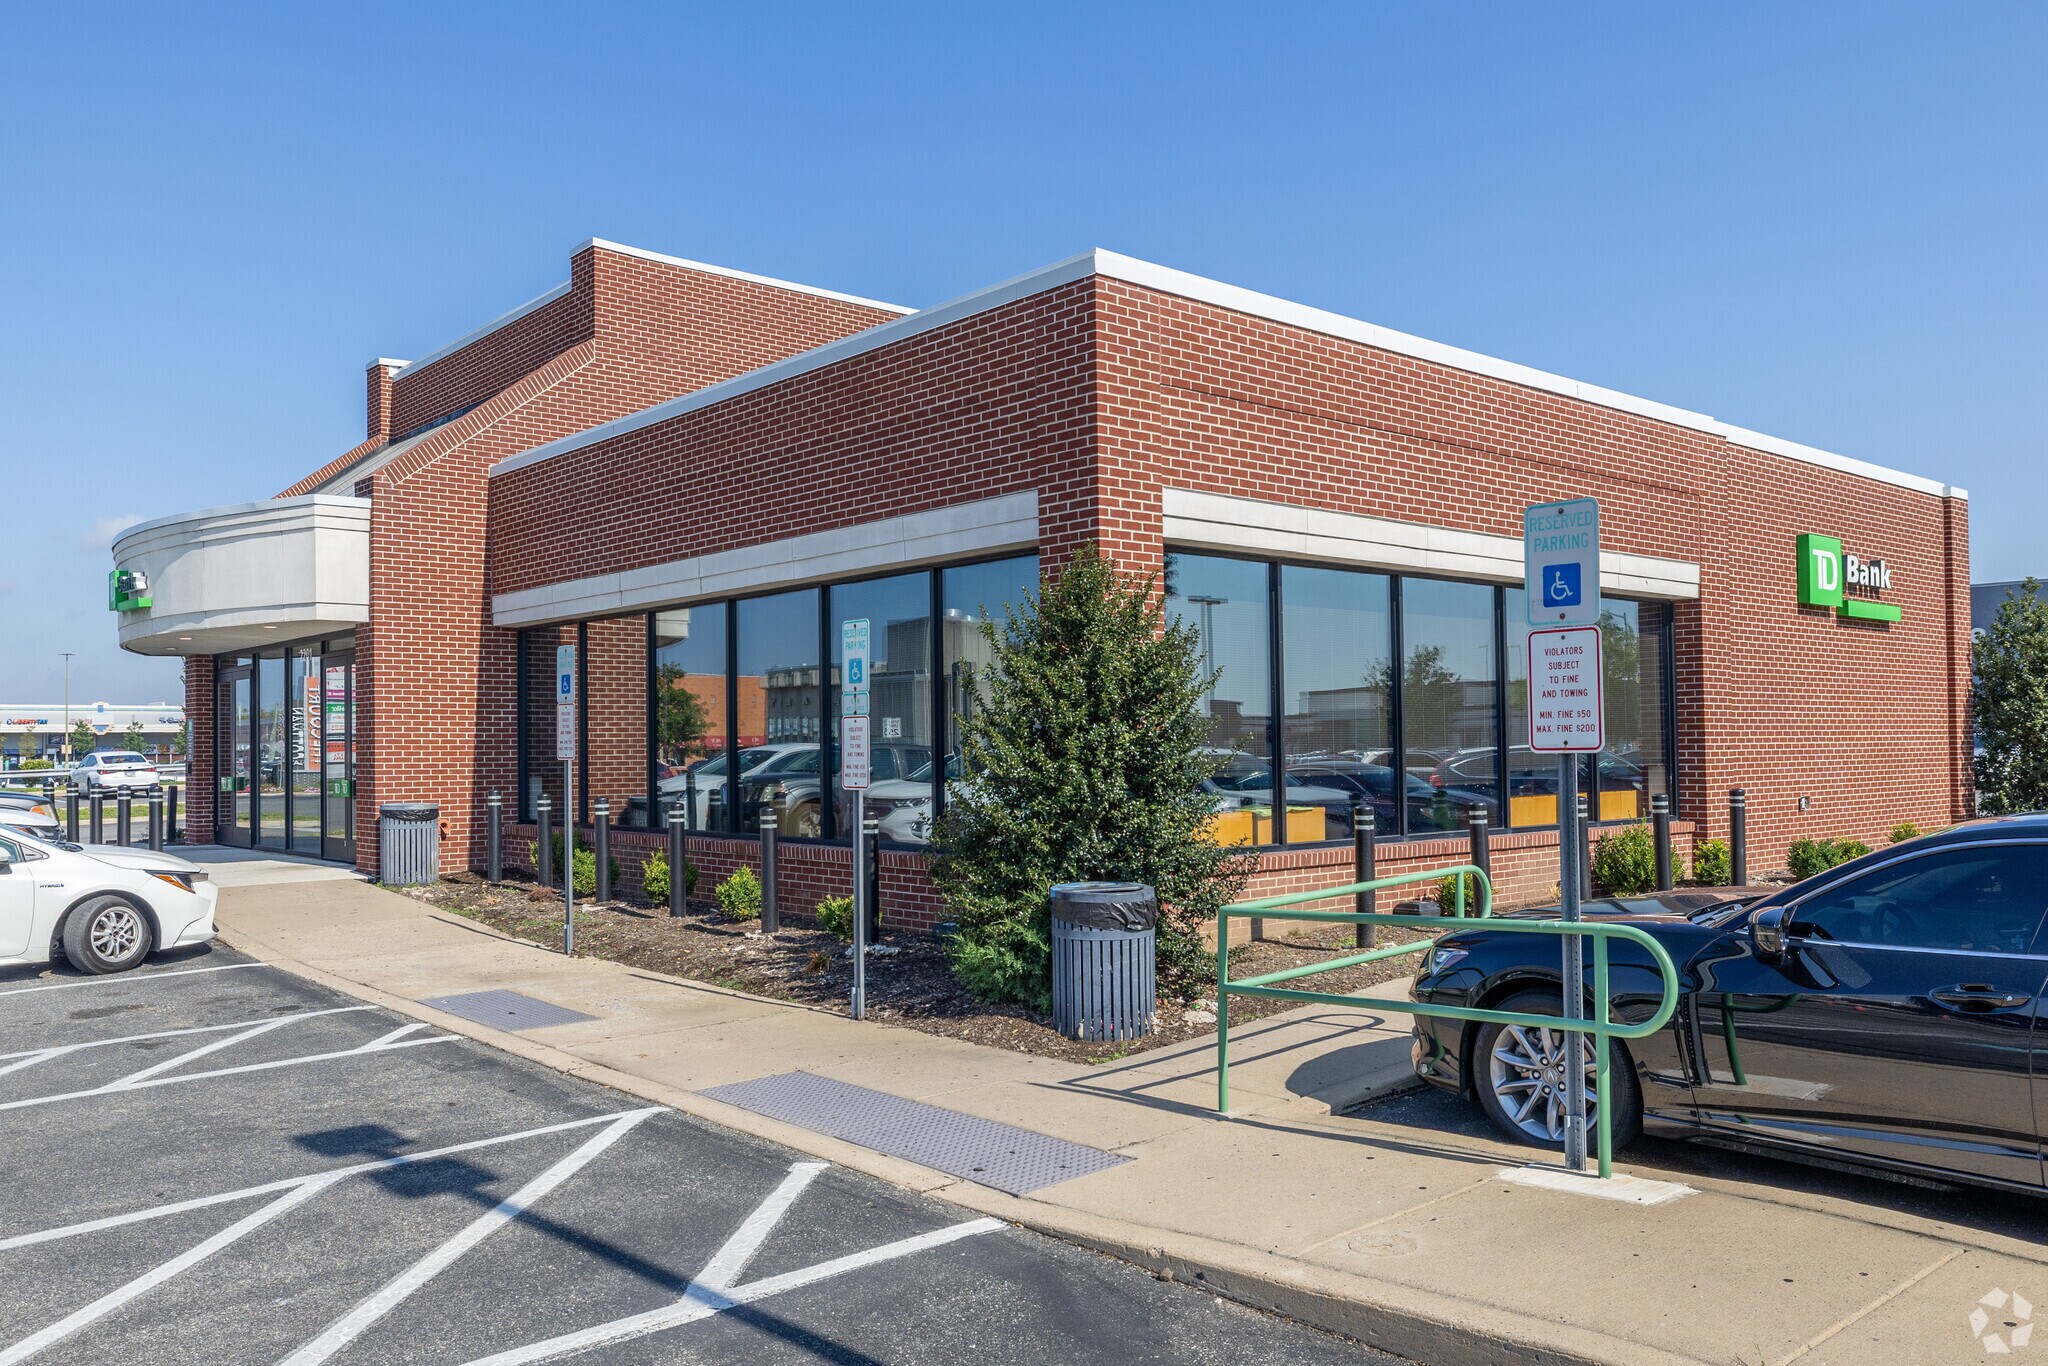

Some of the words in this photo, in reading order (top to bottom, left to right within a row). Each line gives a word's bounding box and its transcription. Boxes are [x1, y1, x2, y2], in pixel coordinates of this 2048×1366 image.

[1529, 511, 1592, 532] RESERVED
[1534, 532, 1589, 552] PARKING
[1812, 549, 1838, 591] TD
[1846, 554, 1892, 589] Bank
[1544, 646, 1584, 656] VIOLATORS
[1548, 661, 1580, 671] SUBJECT
[1549, 676, 1559, 684] TO
[1562, 675, 1580, 684] FINE
[1541, 690, 1557, 699] AND
[1560, 688, 1589, 698] TOWING
[1539, 710, 1555, 719] MIN.
[1557, 710, 1574, 719] FINE
[1576, 709, 1592, 718] $50
[1536, 725, 1554, 733] MAX.
[1556, 724, 1573, 733] FINE
[1575, 723, 1596, 732] $200
